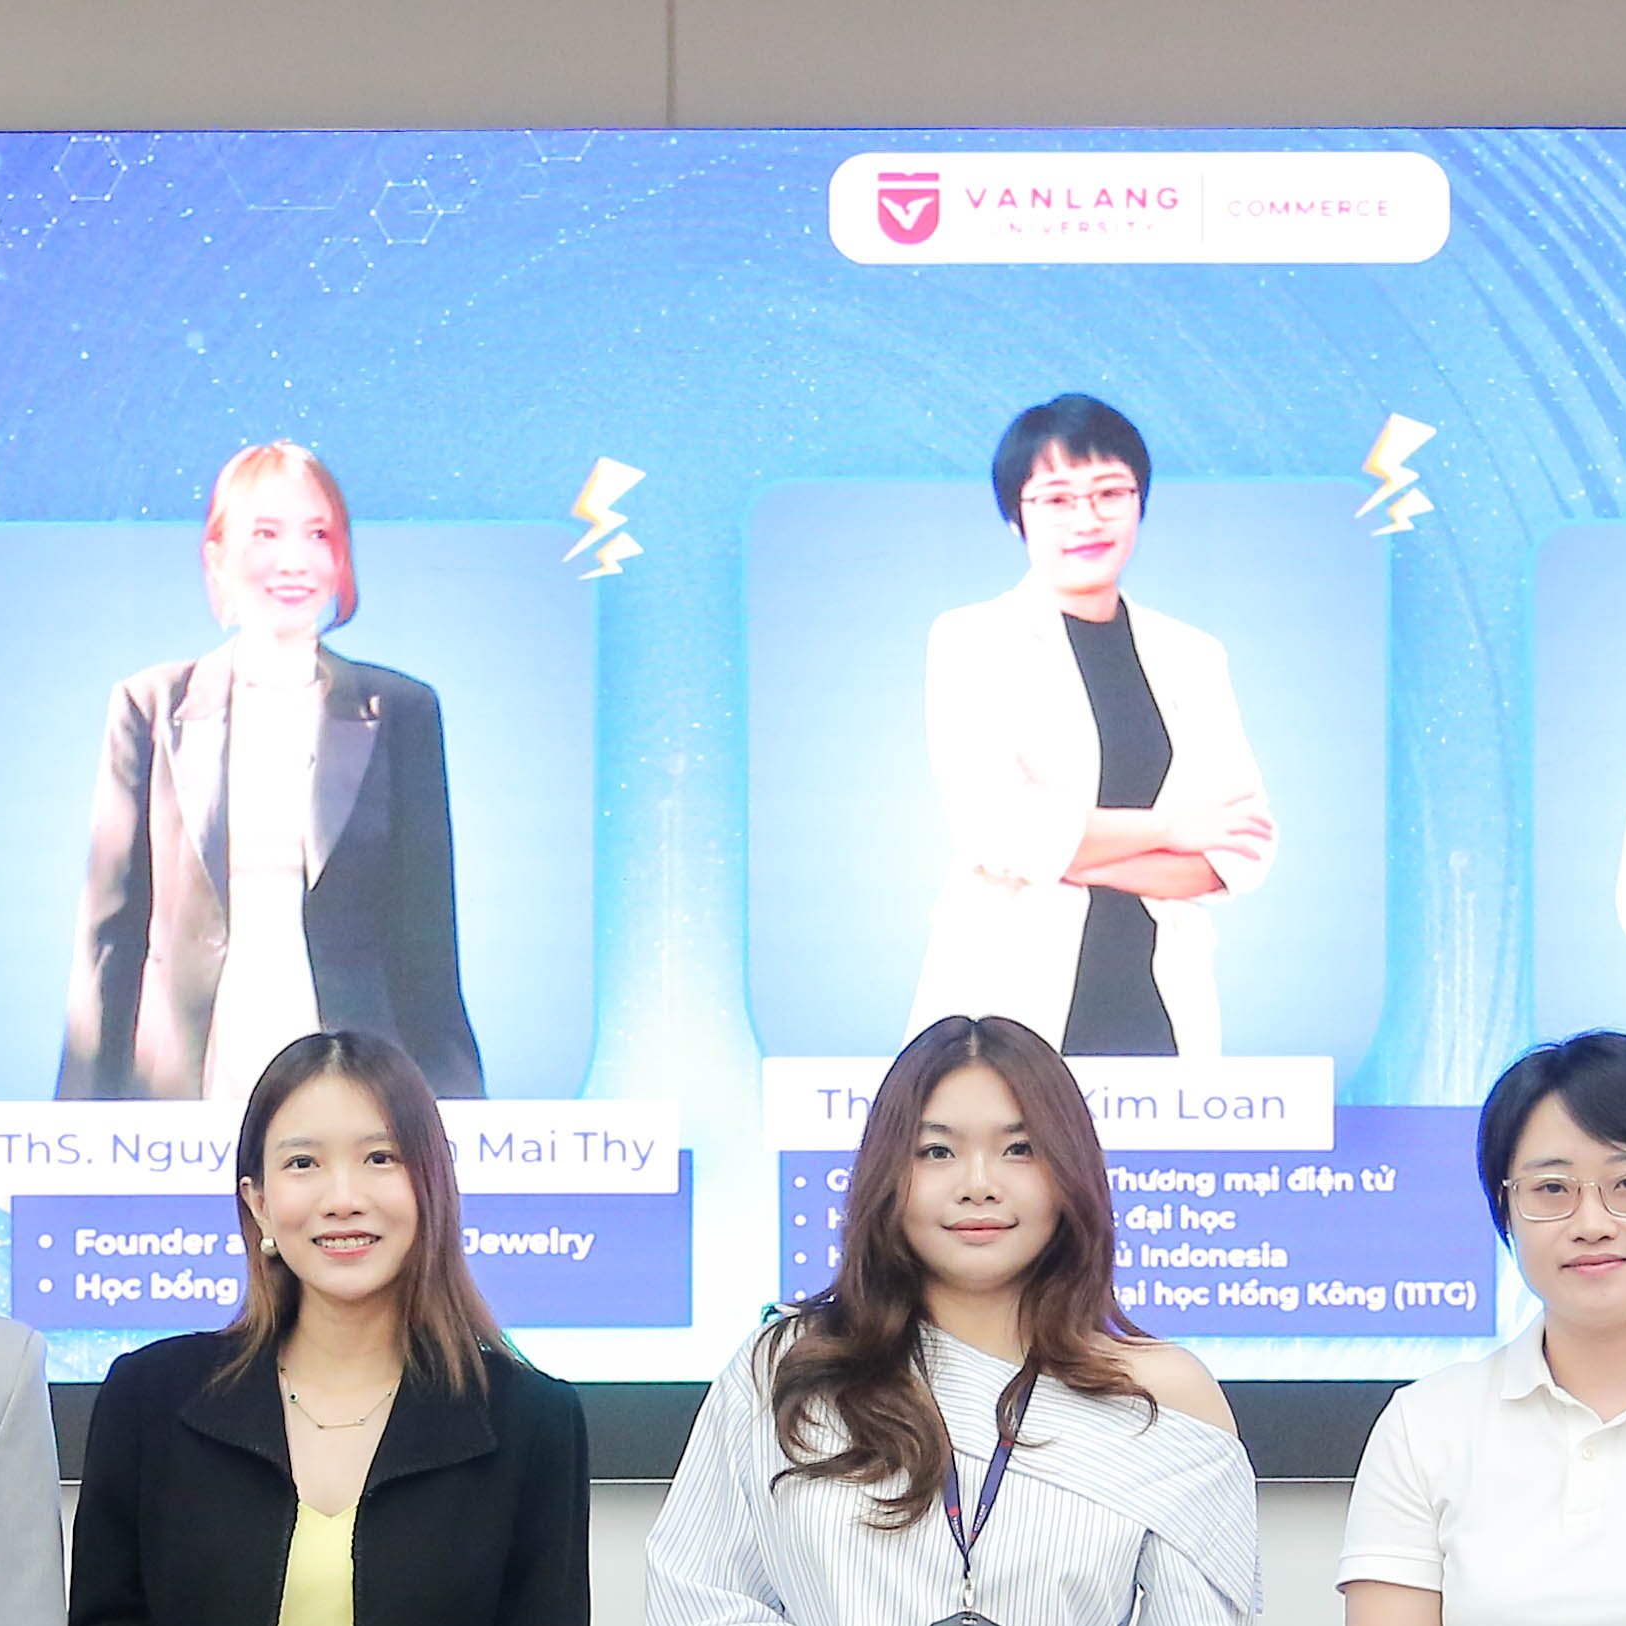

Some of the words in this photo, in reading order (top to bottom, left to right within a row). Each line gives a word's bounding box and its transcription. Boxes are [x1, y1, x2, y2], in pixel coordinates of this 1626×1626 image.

[965, 187, 1179, 209] VANLANG
[1227, 199, 1390, 217] COMMERCE
[1178, 1088, 1285, 1120] Loan
[111, 1132, 234, 1173] Nguy
[479, 1129, 556, 1163] Mai
[573, 1130, 655, 1172] Thy
[1106, 1166, 1216, 1198] Thương
[1223, 1165, 1280, 1198] mại
[1286, 1165, 1355, 1198] điện
[1125, 1203, 1173, 1236] đại
[1179, 1203, 1237, 1236] học
[75, 1227, 219, 1256] Founder
[461, 1226, 595, 1261] Jewelry
[1140, 1240, 1289, 1268] Indonesia
[75, 1272, 143, 1307] Học
[1153, 1279, 1211, 1312] học
[1306, 1279, 1387, 1312] Kông
